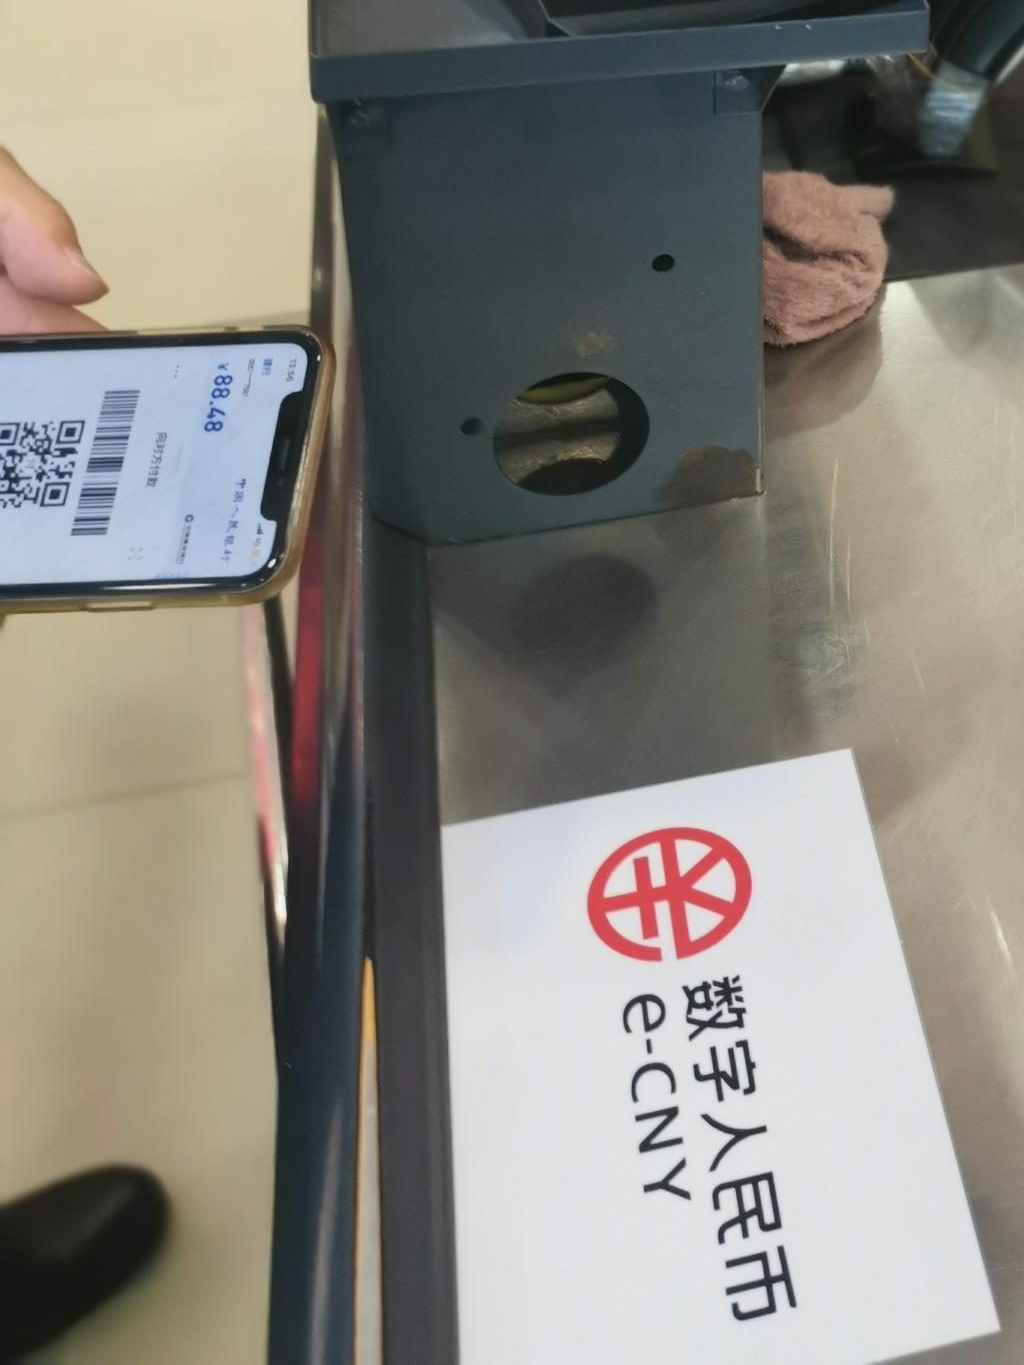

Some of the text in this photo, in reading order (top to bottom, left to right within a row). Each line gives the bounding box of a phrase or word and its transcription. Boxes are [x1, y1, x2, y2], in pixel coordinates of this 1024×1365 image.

[622, 993, 692, 1201] e-CNY
[682, 974, 798, 1322] 数字人民币
